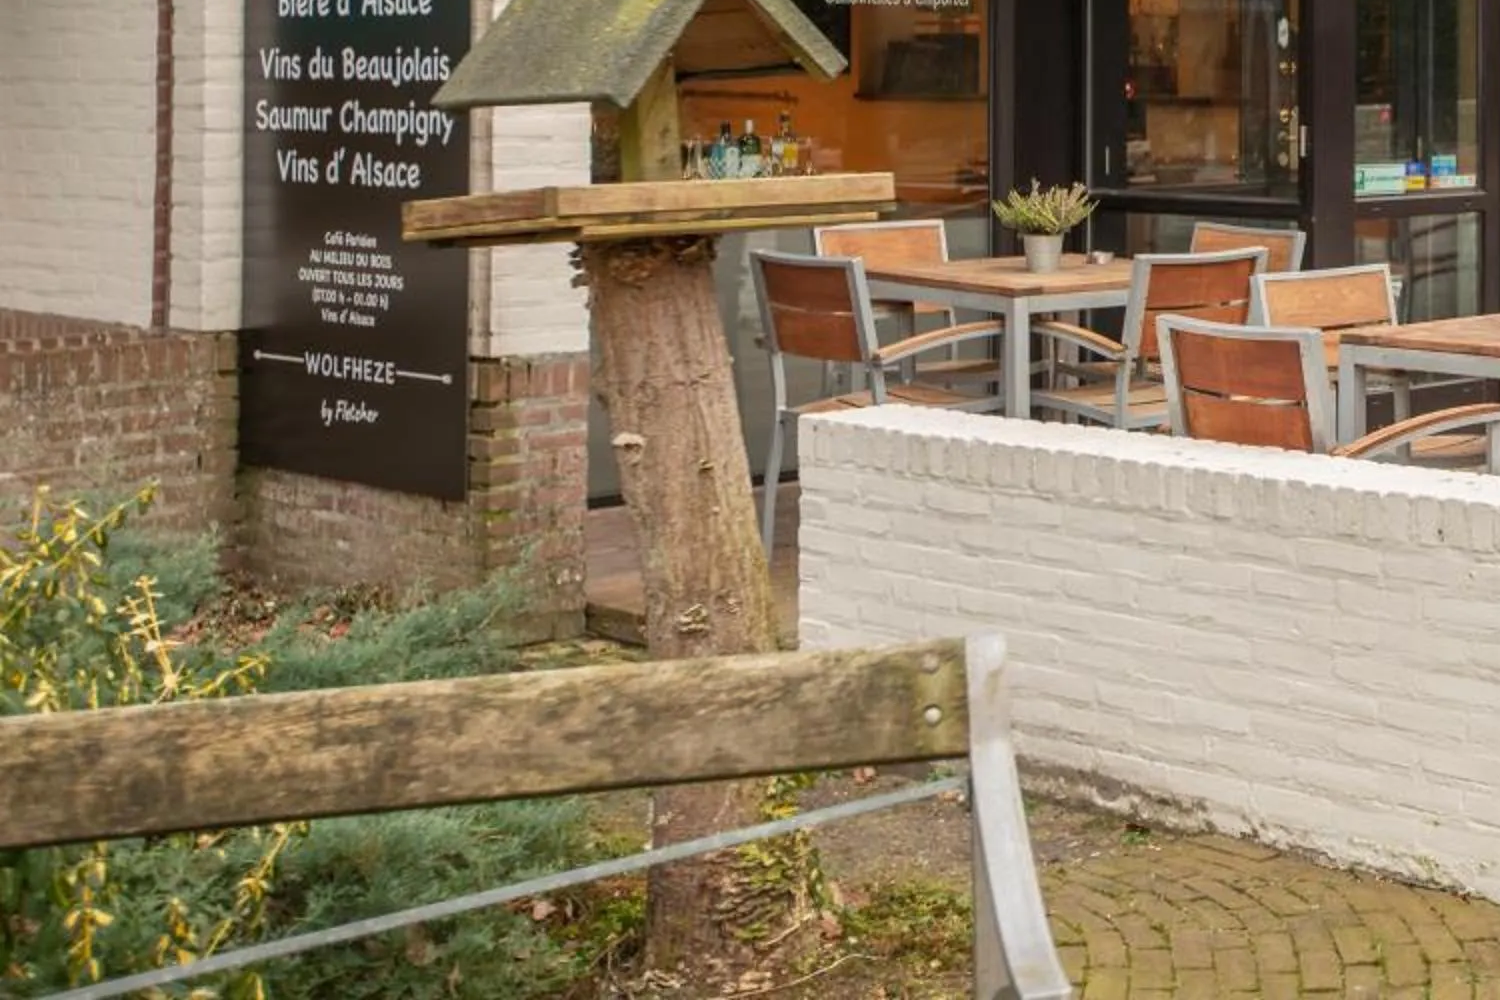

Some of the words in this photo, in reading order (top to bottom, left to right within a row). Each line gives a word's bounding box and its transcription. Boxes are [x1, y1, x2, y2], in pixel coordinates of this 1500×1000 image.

[259, 46, 301, 80] Vins
[308, 45, 335, 80] du
[342, 46, 450, 87] Beaujolais
[256, 99, 332, 132] Saumur
[339, 99, 454, 145] Champigny
[277, 149, 319, 183] Vins
[351, 152, 421, 189] Alsace
[304, 351, 395, 385] WOLFHEZE
[321, 399, 333, 427] by
